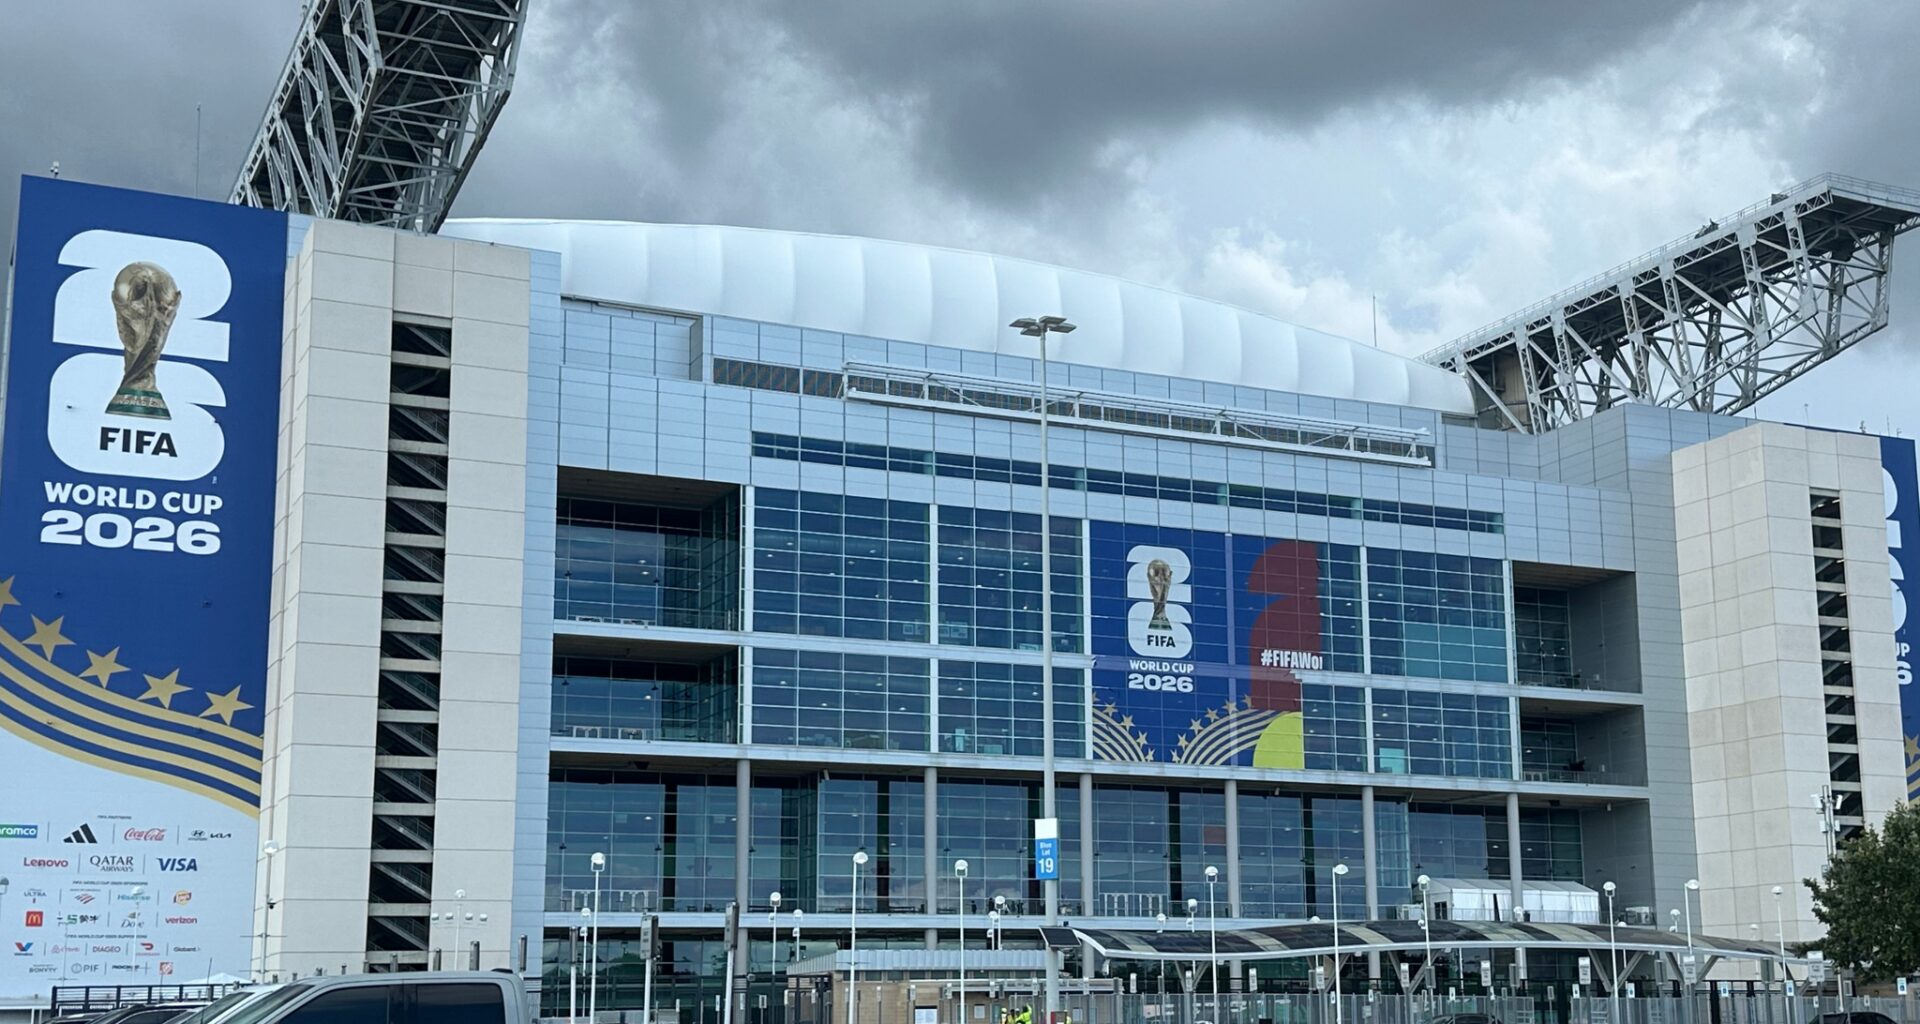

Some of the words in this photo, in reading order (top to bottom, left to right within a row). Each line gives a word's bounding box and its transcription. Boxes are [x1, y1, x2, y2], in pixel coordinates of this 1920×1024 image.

[99, 427, 178, 457] FIFA
[44, 482, 157, 510] WORLD
[162, 491, 223, 515] CUP
[40, 509, 221, 555] 2026
[1147, 634, 1176, 648] FIFA
[1129, 660, 1170, 672] WORLD
[1172, 662, 1194, 674] CUP
[1128, 673, 1193, 693] 2026
[23, 857, 69, 868] Lenovo
[89, 855, 134, 868] QATAR
[156, 858, 198, 872] VISA
[1038, 857, 1054, 874] 19
[121, 919, 145, 928] Doe
[83, 964, 101, 973] PIF
